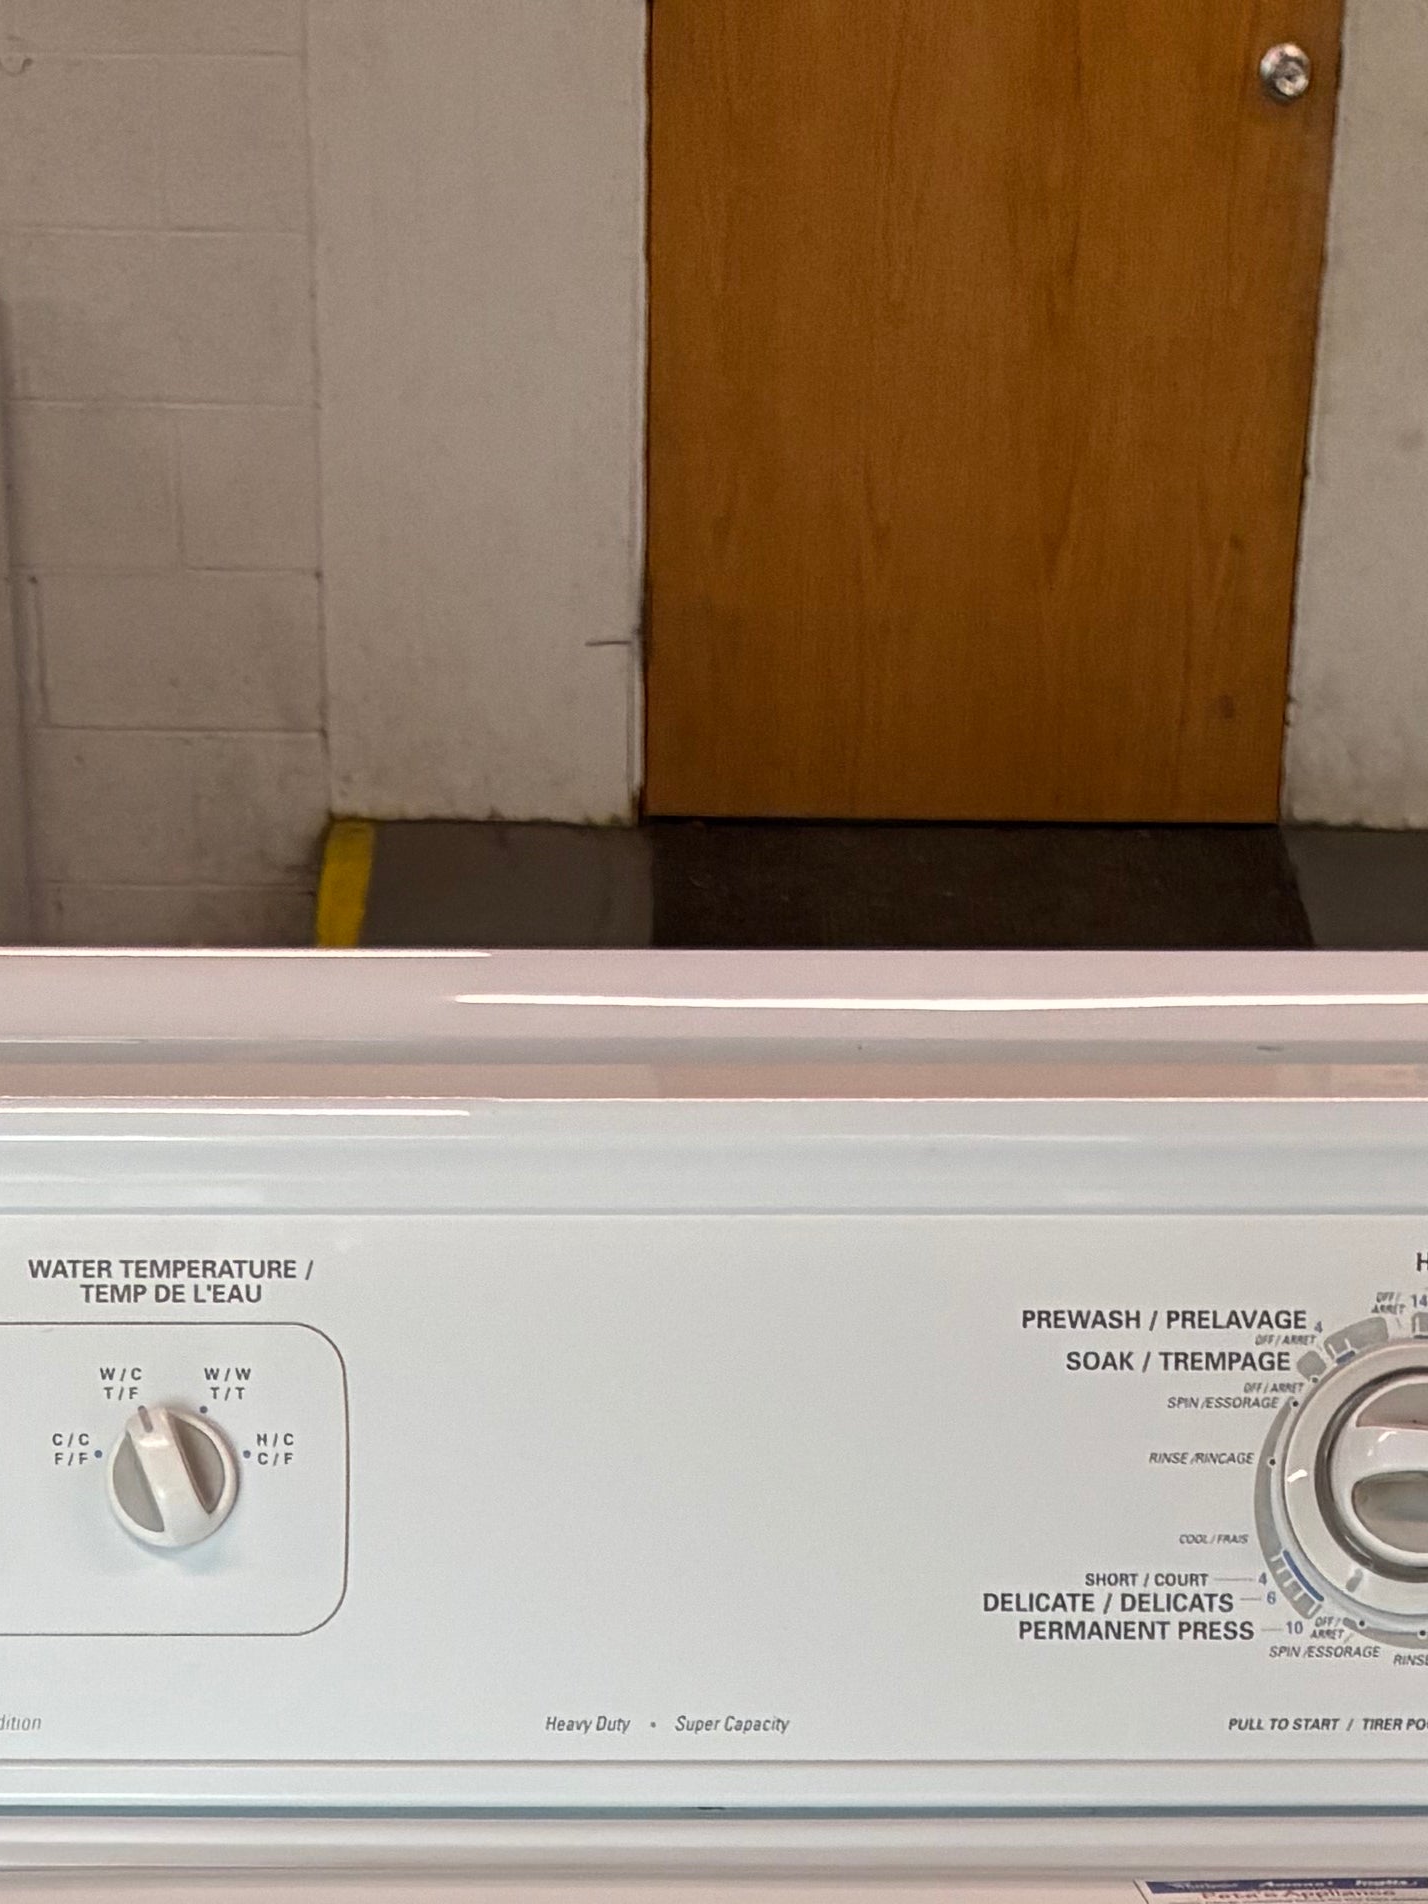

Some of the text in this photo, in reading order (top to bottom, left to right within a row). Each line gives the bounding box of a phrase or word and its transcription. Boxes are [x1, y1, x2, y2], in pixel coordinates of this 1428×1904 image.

[28, 1259, 297, 1279] WATER TEMPERATURE
[80, 1284, 262, 1303] TEMP DE L'EAU
[1411, 1294, 1428, 1308] 14
[1022, 1310, 1307, 1330] PREWASH PRELAVAGE
[1066, 1352, 1291, 1371] SOAK TREMPAGE
[1167, 1397, 1200, 1409] SPIN
[1149, 1452, 1188, 1464] RINSE
[1085, 1573, 1209, 1587] SHORT COURT
[1258, 1573, 1267, 1585] 4
[983, 1593, 1234, 1613] DELICATE DELICATS
[1019, 1621, 1254, 1641] PERMANENT PRESS
[1286, 1621, 1303, 1635] 10
[1269, 1646, 1300, 1659] SPIN
[545, 1716, 631, 1734] Heavy Duty
[675, 1715, 790, 1734] Super Capacity
[1228, 1718, 1264, 1731] PULL
[1270, 1718, 1289, 1731] TO
[1292, 1718, 1340, 1731] START
[1362, 1718, 1403, 1731] TIRER
